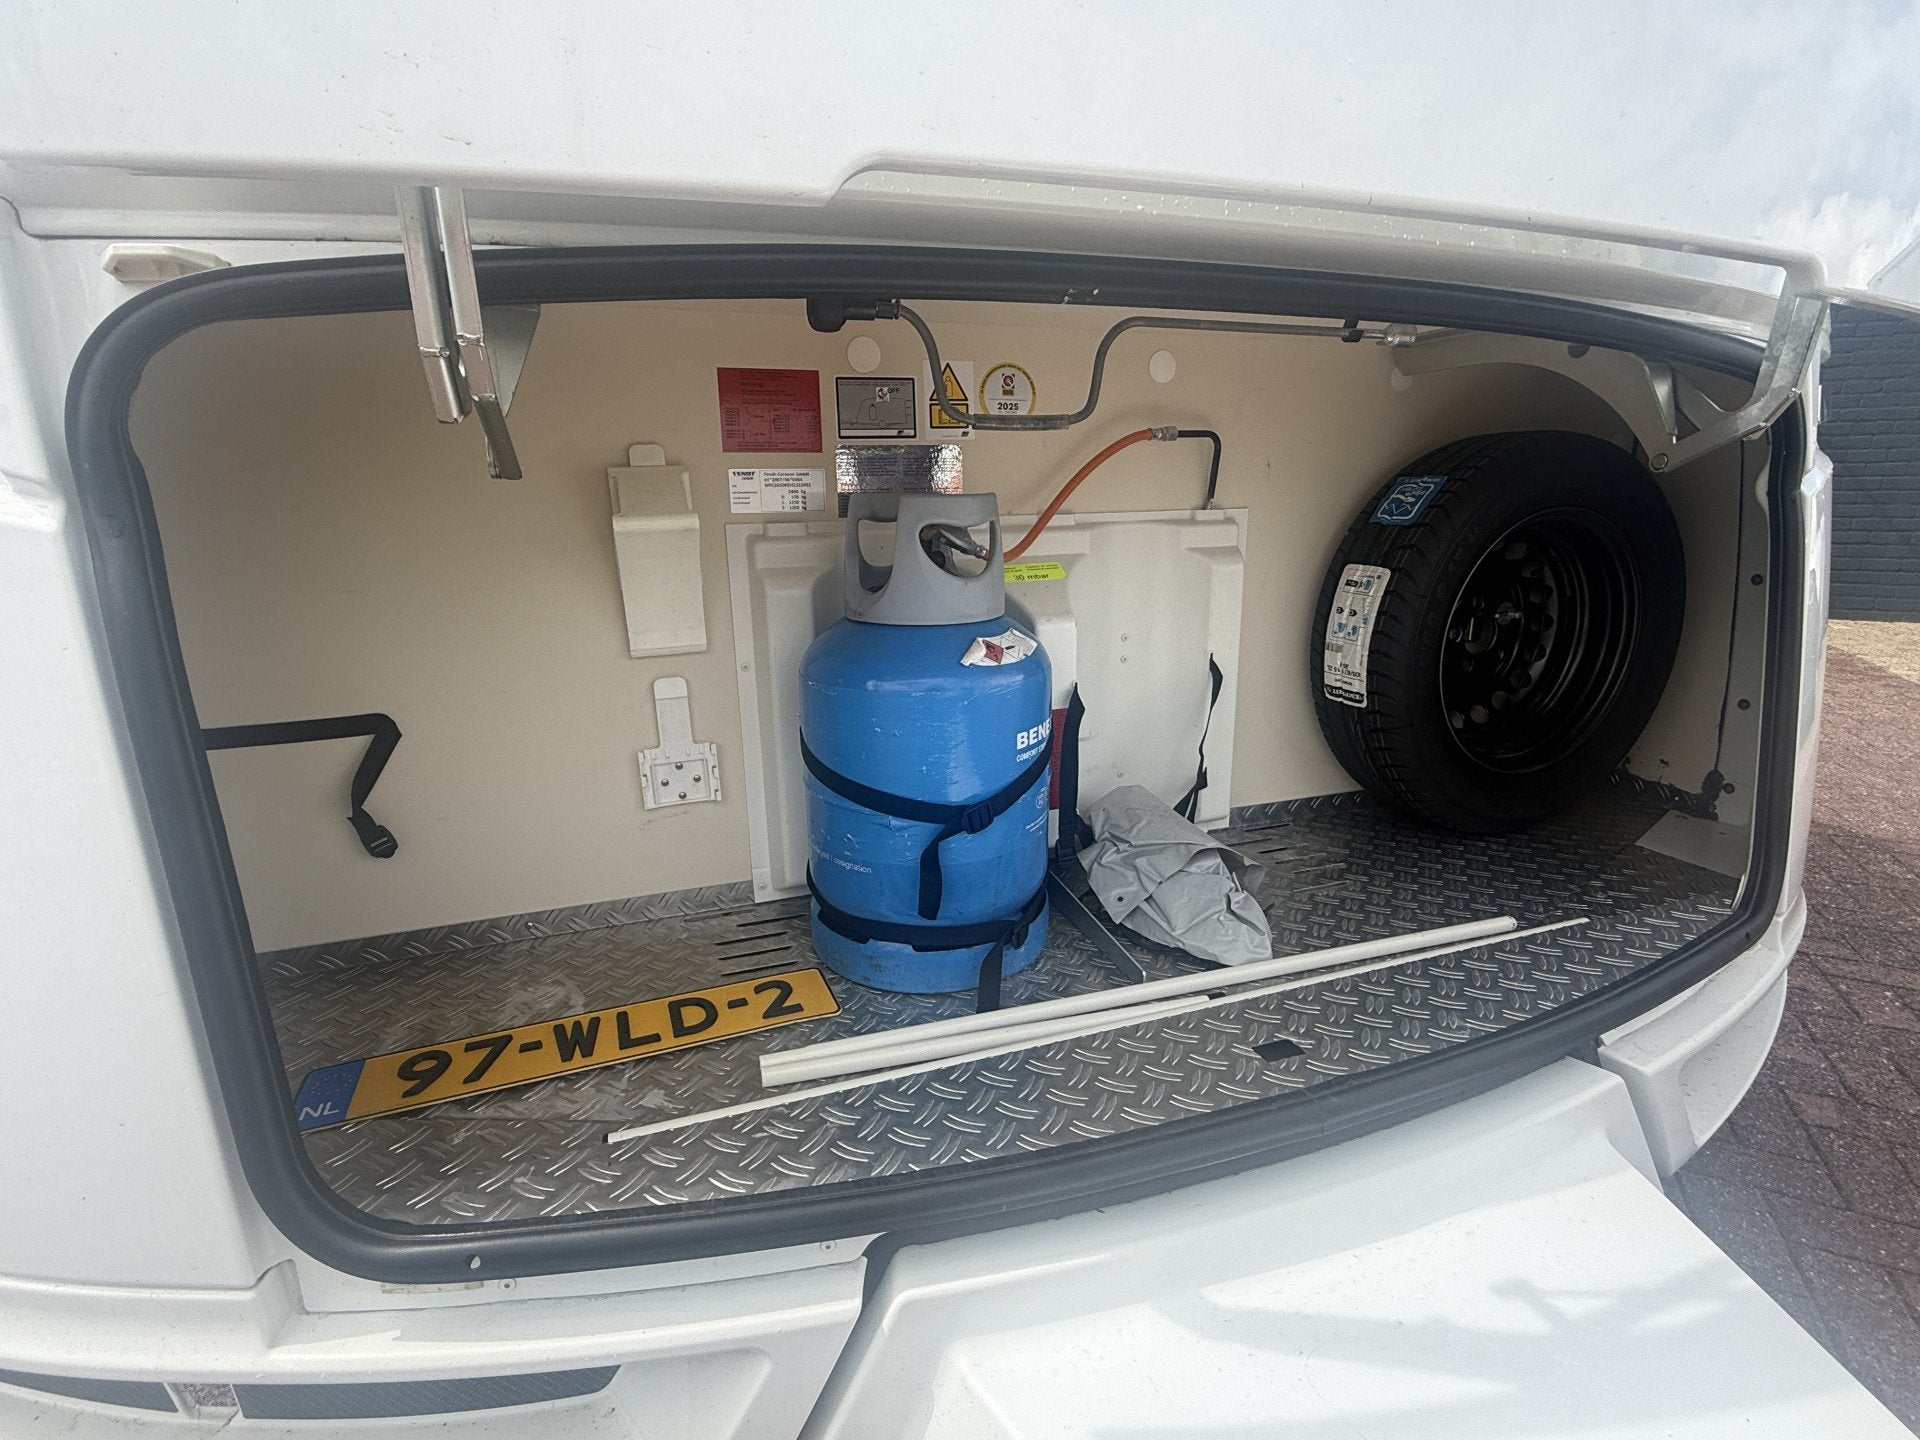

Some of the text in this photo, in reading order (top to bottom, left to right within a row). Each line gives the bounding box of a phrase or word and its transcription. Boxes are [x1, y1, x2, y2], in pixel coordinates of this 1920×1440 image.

[887, 386, 900, 394] OFF
[997, 402, 1019, 411] 2025
[833, 858, 872, 874] consignation
[396, 980, 805, 1099] 97-WLD-2
[300, 1101, 341, 1119] NL
